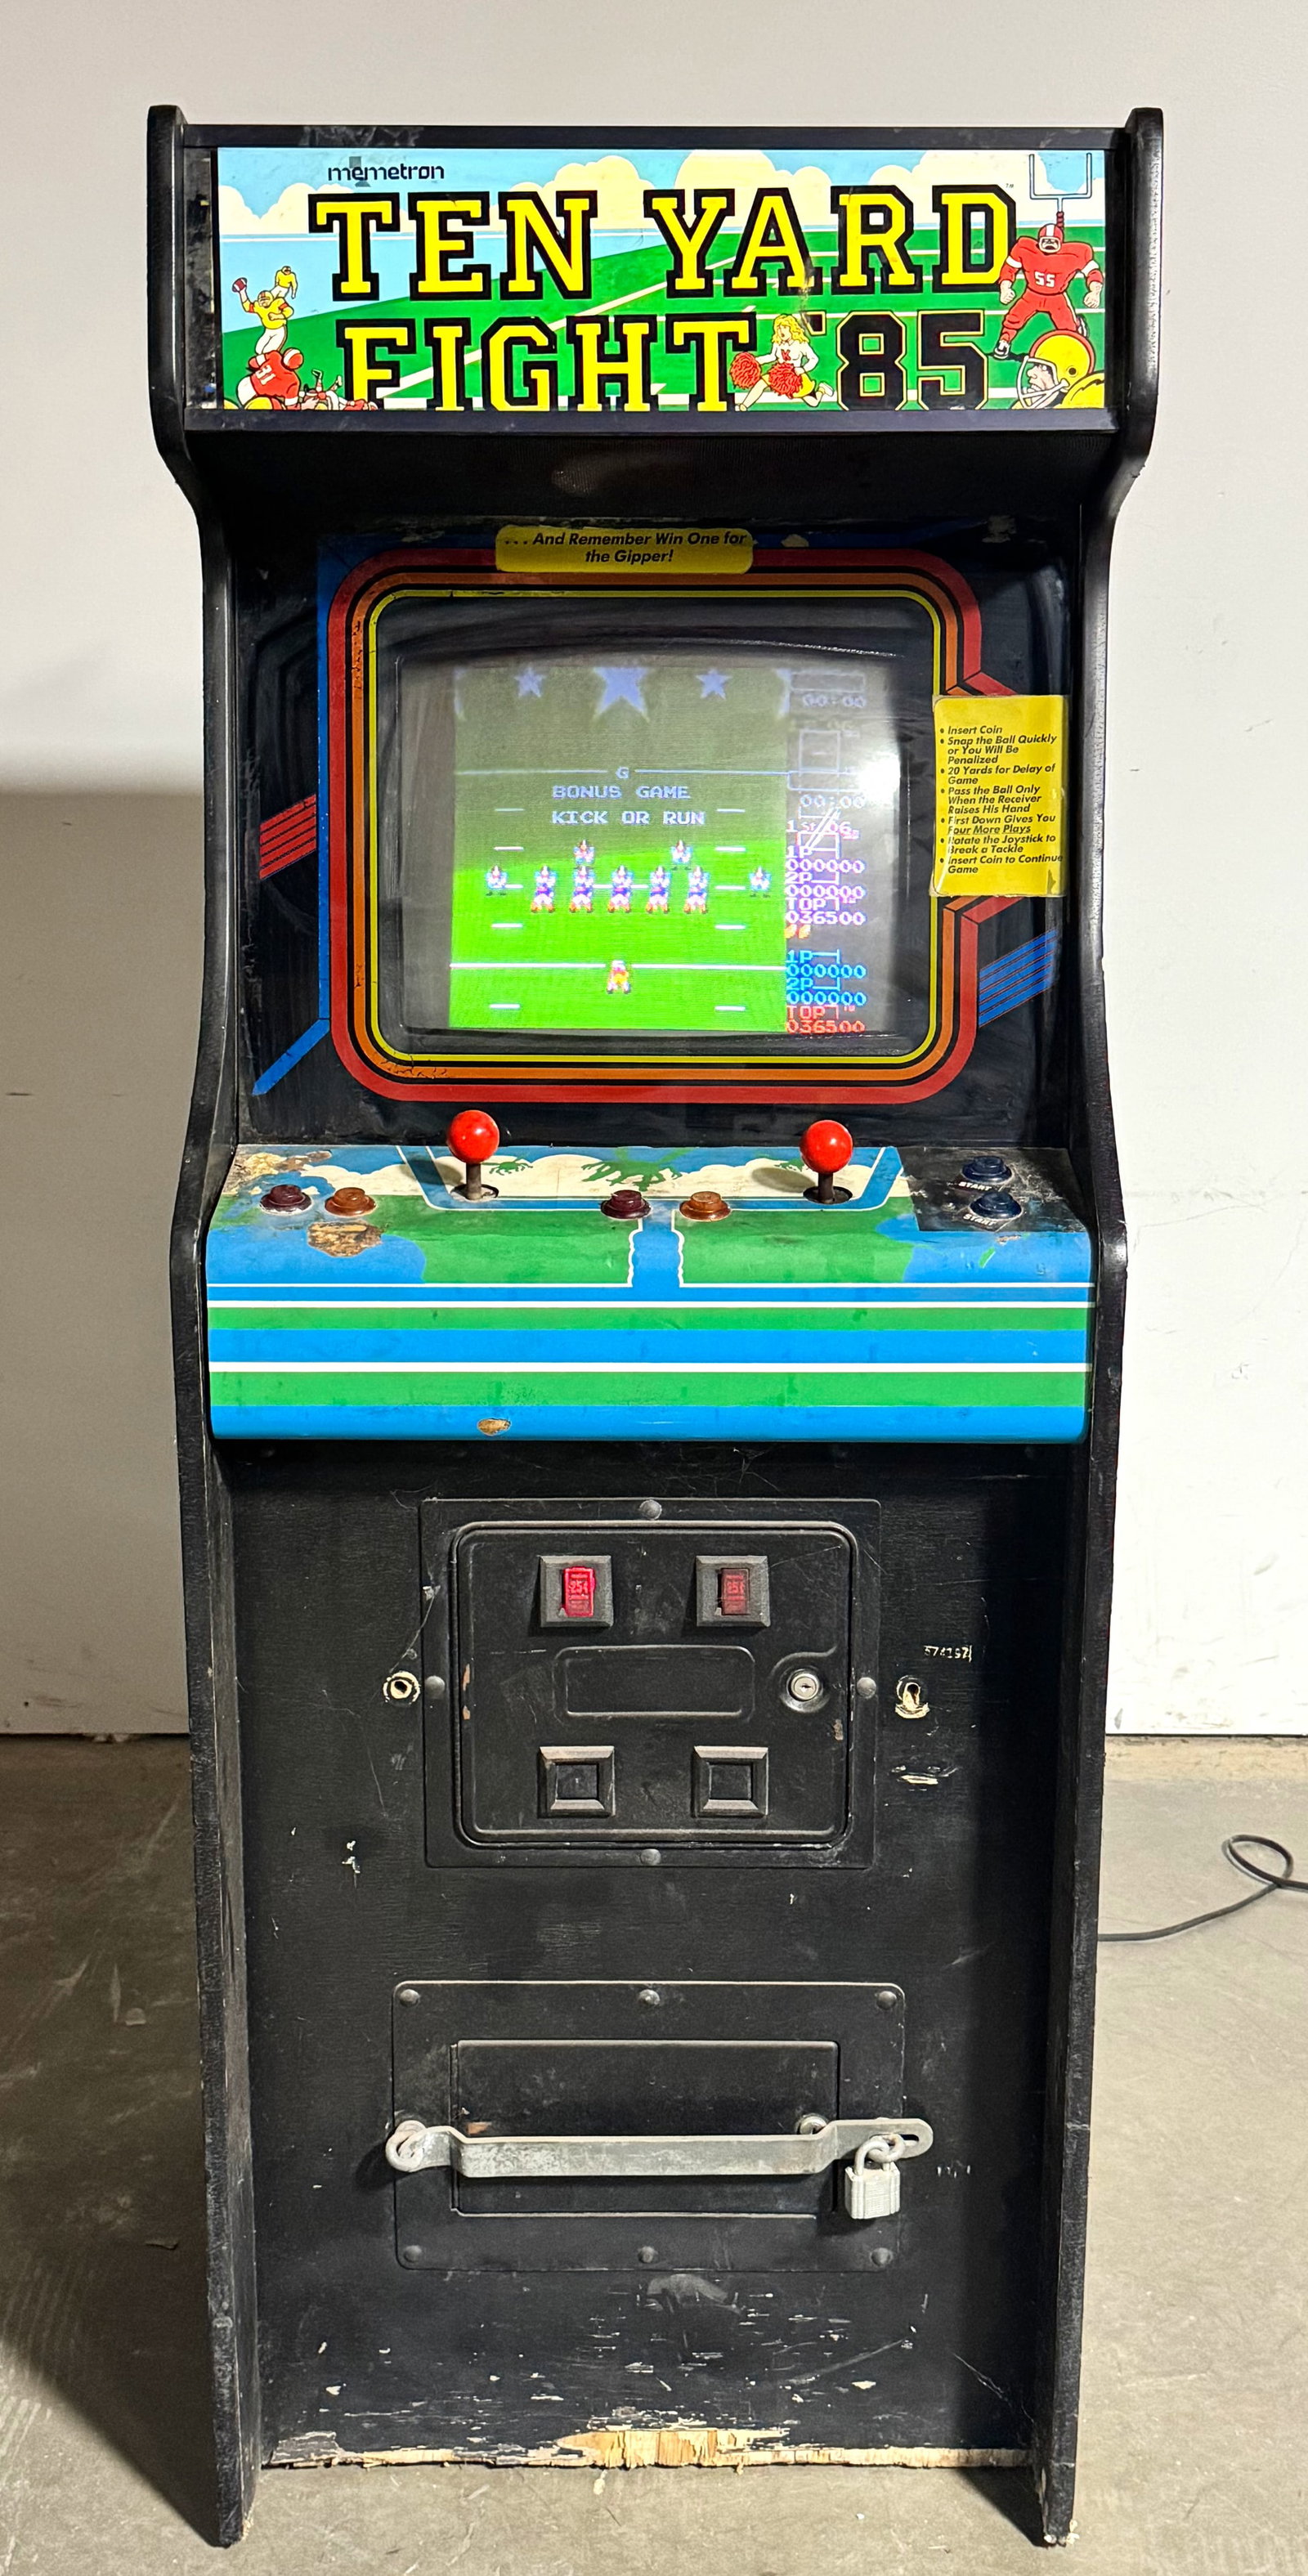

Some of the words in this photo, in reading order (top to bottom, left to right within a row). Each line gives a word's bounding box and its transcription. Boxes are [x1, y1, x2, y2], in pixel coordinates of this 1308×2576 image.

[328, 163, 444, 181] memetron
[308, 190, 598, 302] TEN
[643, 185, 1017, 298] YARD
[1033, 271, 1056, 288] 55
[335, 312, 757, 411] FIGHT
[532, 532, 564, 545] And
[568, 532, 652, 545] Remember
[656, 532, 683, 545] Win
[687, 532, 720, 545] One
[723, 531, 748, 545] for
[585, 549, 611, 562] the
[613, 549, 674, 566] Gipper!
[947, 725, 976, 734] Insert
[980, 725, 1002, 734] Coin
[947, 737, 973, 747] Snap
[976, 737, 992, 745] the
[995, 735, 1015, 744] Ball
[1018, 733, 1057, 744] Quickly
[961, 746, 981, 755] You
[985, 746, 1003, 754] Will
[1006, 746, 1019, 754] Be
[947, 755, 998, 764] Penalized
[615, 766, 629, 779] G
[964, 766, 992, 774] Yards
[995, 765, 1010, 773] for
[1012, 765, 1042, 775] Delay
[1045, 764, 1056, 773] of
[948, 776, 979, 785] Game
[552, 785, 622, 799] BONUS
[635, 785, 691, 799] GAME
[948, 786, 971, 795] Pass
[974, 786, 990, 795] the
[992, 785, 1013, 794] Ball
[1015, 784, 1041, 795] Only
[948, 796, 975, 805] When
[978, 795, 995, 804] the
[997, 795, 1042, 804] Receiver
[948, 806, 980, 814] Raises
[983, 805, 999, 813] His
[1002, 804, 1030, 813] Hand
[552, 810, 608, 825] KICK
[621, 810, 650, 825] OR
[663, 810, 706, 825] RUN
[948, 817, 969, 825] First
[972, 816, 1001, 824] Down
[1004, 814, 1033, 823] Gives
[1037, 813, 1056, 822] You
[947, 826, 970, 835] Four
[974, 825, 1000, 834] More
[1002, 824, 1031, 835] Plays
[983, 835, 1000, 844] the
[1002, 833, 1043, 845] Joystick
[948, 845, 979, 854] Break
[991, 844, 1024, 853] Tackle
[948, 856, 977, 864] Insert
[980, 855, 1003, 864] Coin
[1019, 854, 1063, 863] Continue
[786, 859, 867, 873] 000000
[947, 866, 979, 874] Game
[785, 871, 813, 884] 2P
[786, 885, 867, 899] 000000
[786, 898, 826, 910] TOP
[786, 911, 867, 925] 036500
[786, 950, 813, 963] 1P
[786, 964, 867, 979] 000000
[785, 978, 813, 991] 2P
[786, 992, 867, 1006] 000000
[786, 1006, 826, 1019] TOP
[786, 1020, 866, 1033] 036500
[958, 1181, 992, 1191] START
[963, 1214, 997, 1226] START
